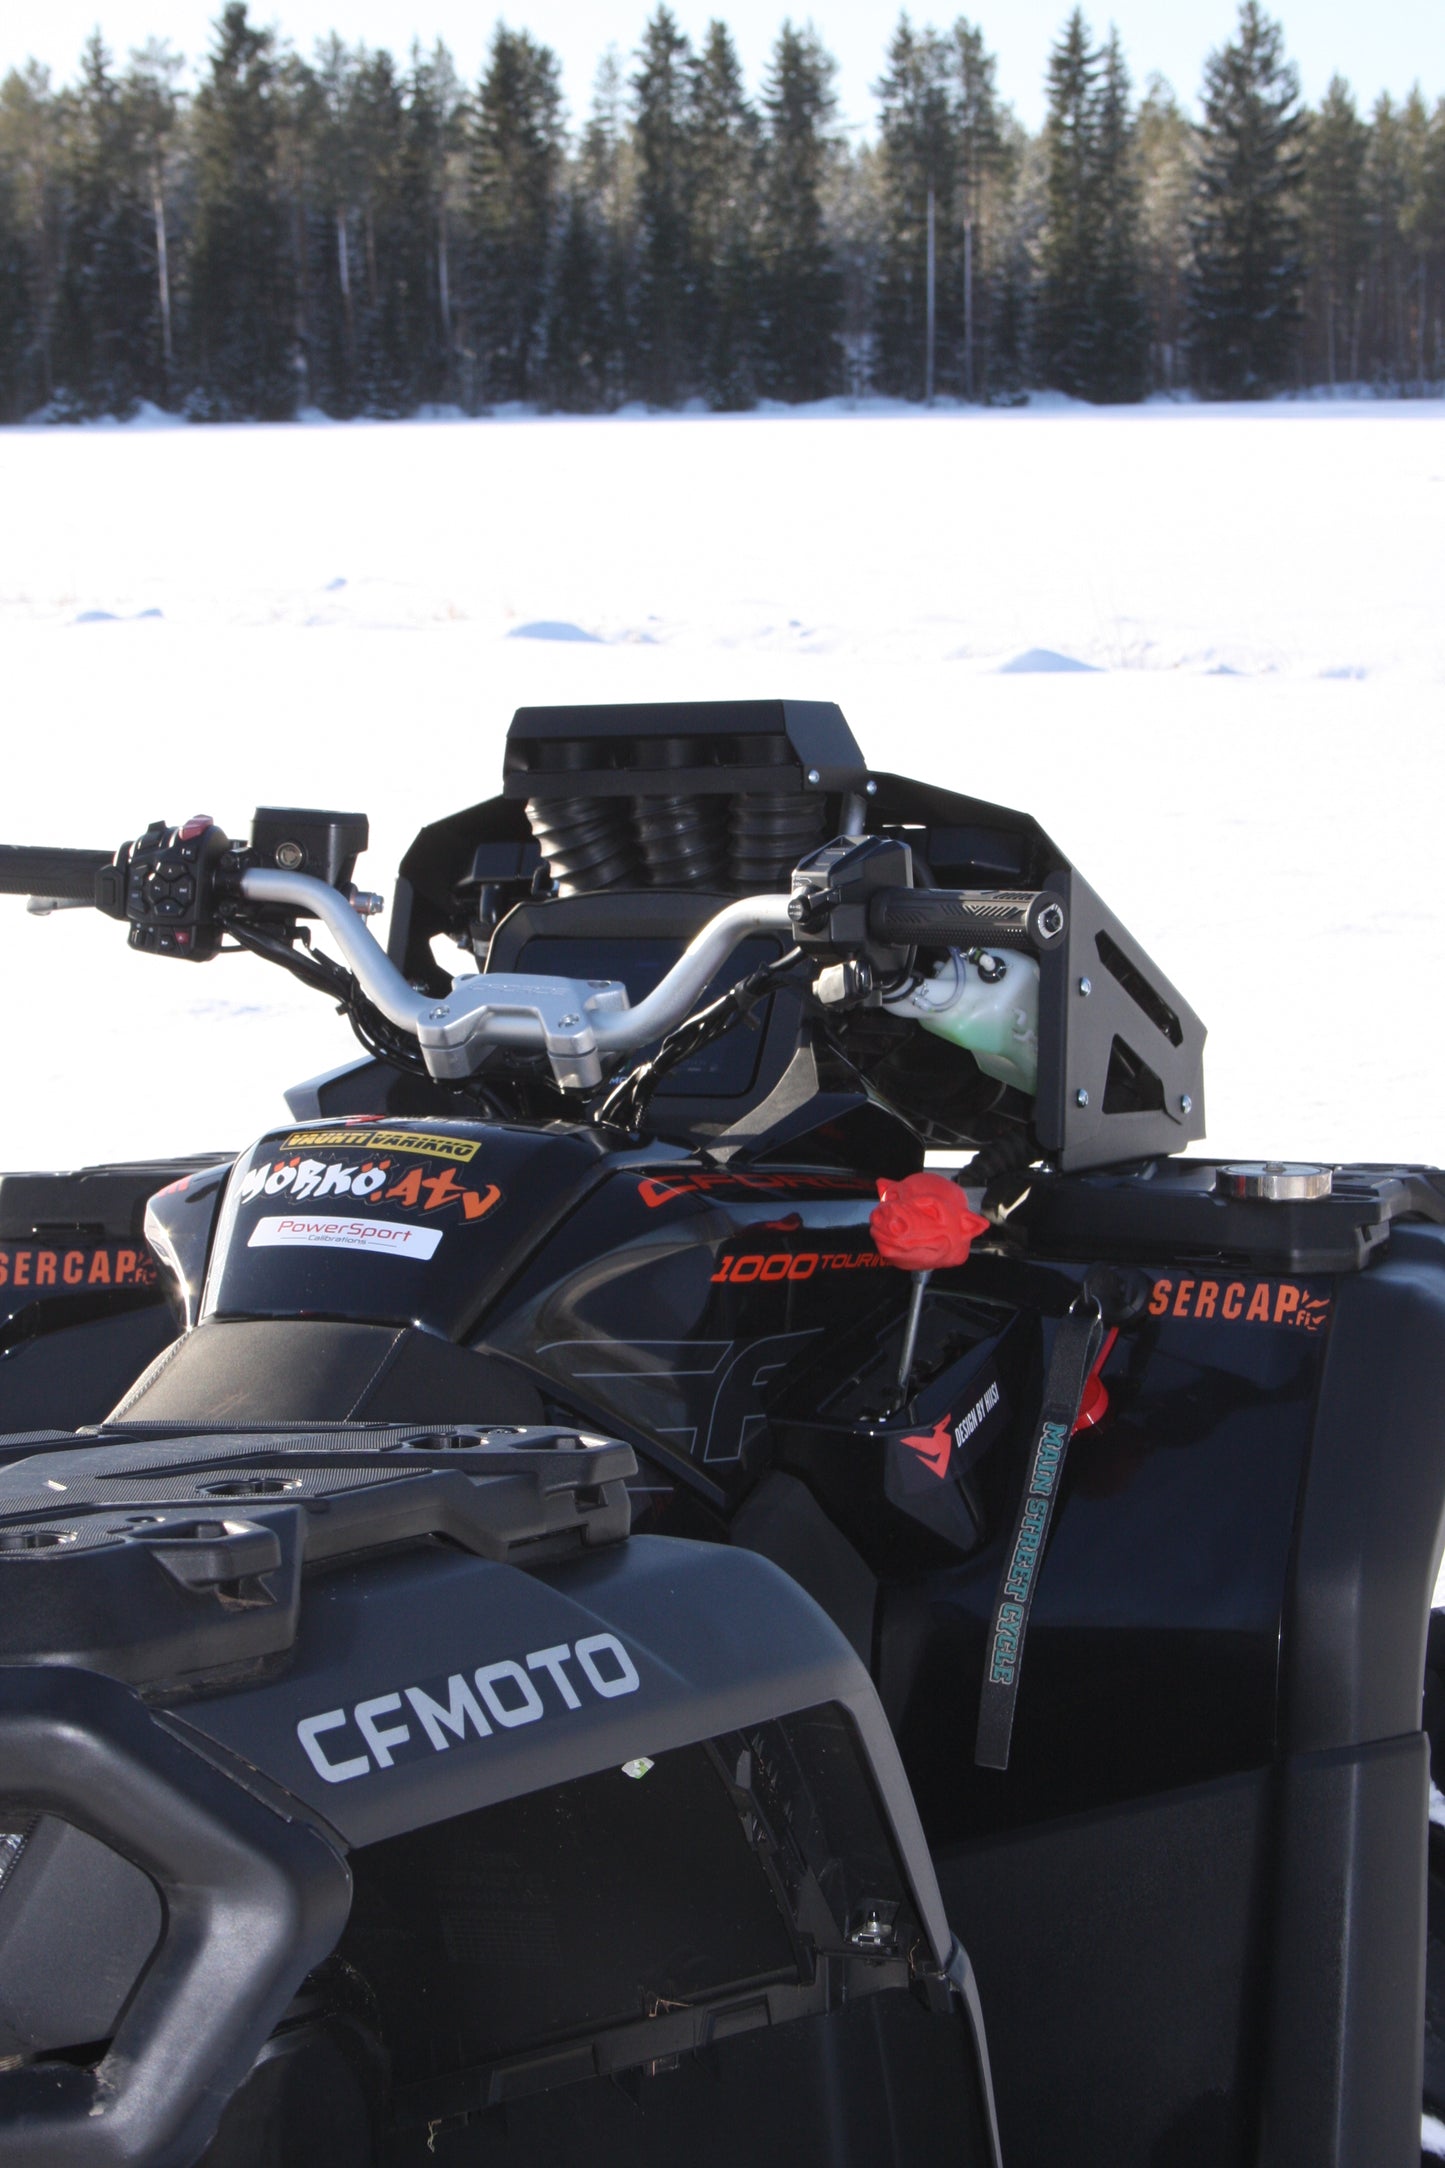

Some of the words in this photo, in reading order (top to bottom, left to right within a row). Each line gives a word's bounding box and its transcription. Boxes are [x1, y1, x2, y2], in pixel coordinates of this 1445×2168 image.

[287, 1131, 372, 1147] VAUHTI
[371, 1133, 475, 1157] VARIKKO
[637, 1173, 876, 1208] CFORC
[276, 1220, 413, 1242] PowerSport
[307, 1234, 367, 1246] Calibrations
[710, 1253, 819, 1283] 1000
[821, 1253, 892, 1270] TOURIN
[954, 1407, 978, 1449] DESIGN
[975, 1396, 986, 1423] BY
[1029, 1421, 1068, 1497] MAIN
[1004, 1497, 1049, 1603] STREET
[989, 1602, 1025, 1686] CYCLE
[297, 1632, 640, 1784] CFMOTO
